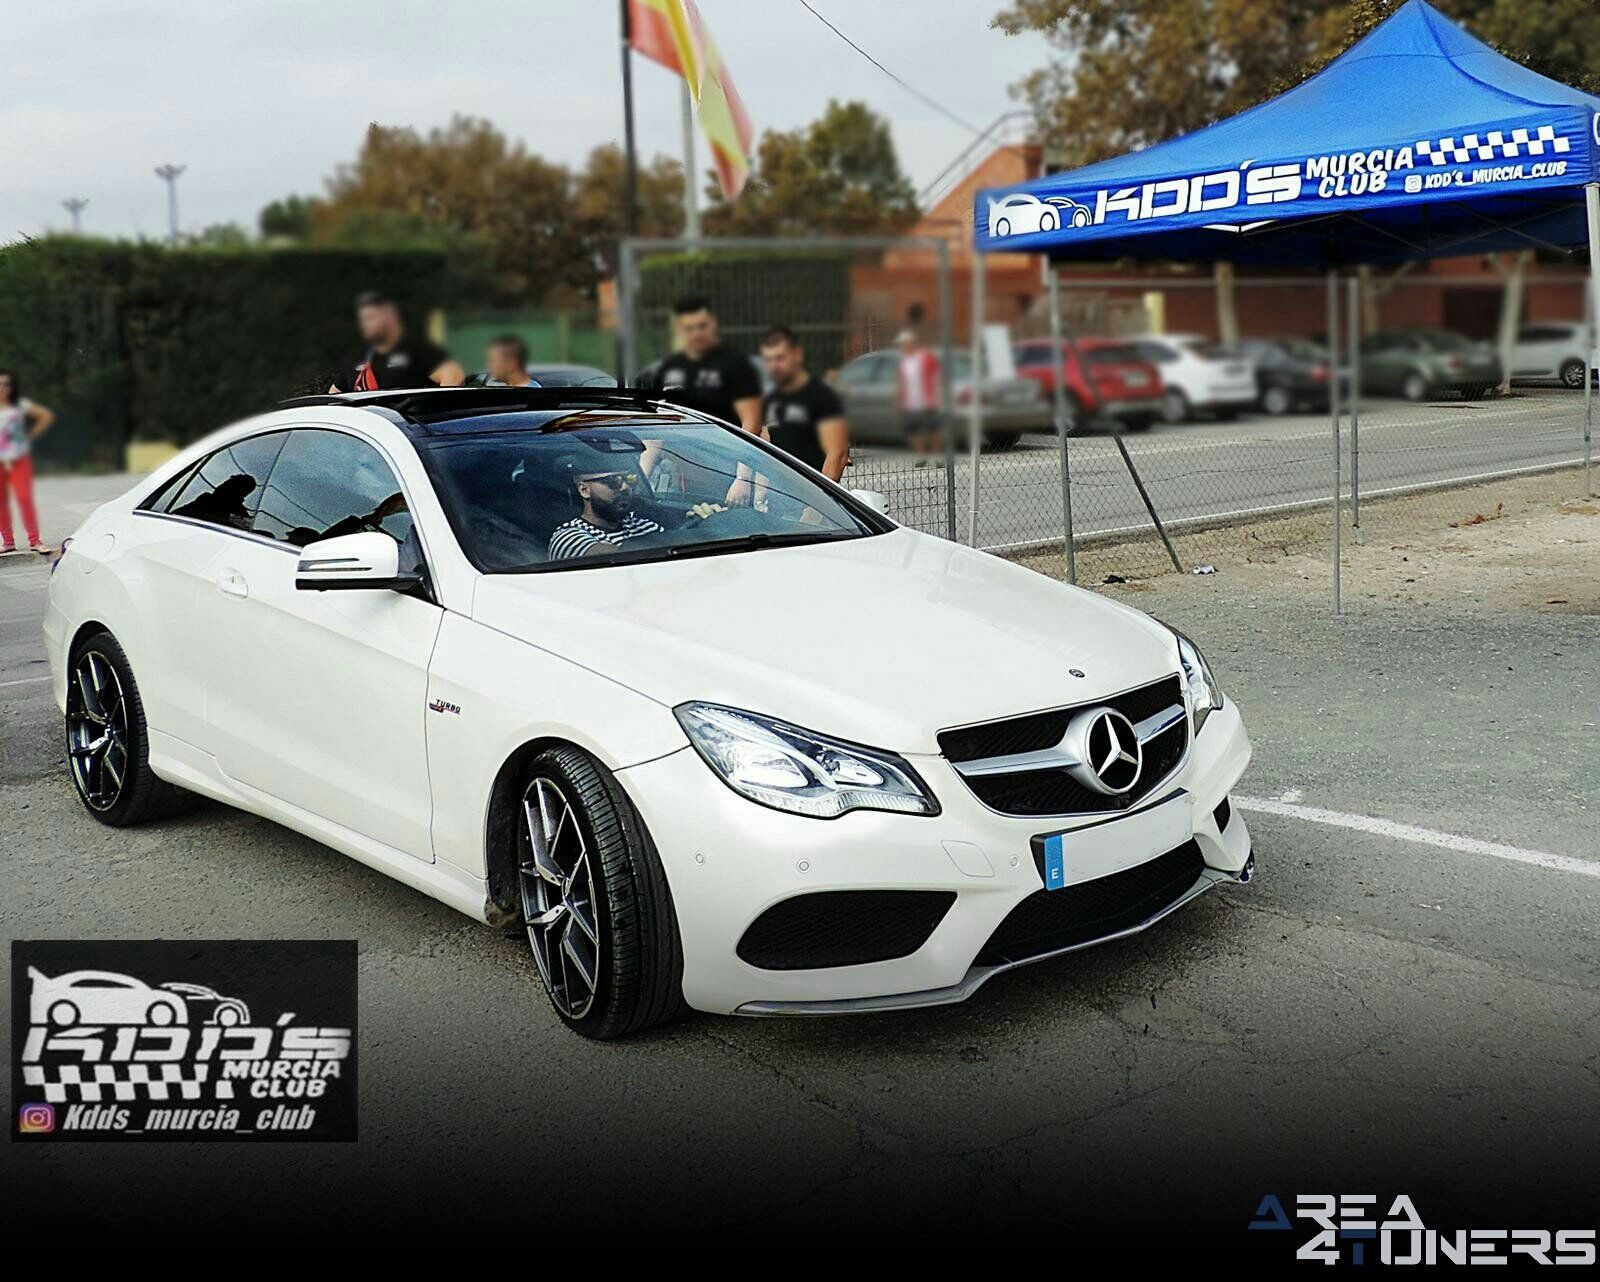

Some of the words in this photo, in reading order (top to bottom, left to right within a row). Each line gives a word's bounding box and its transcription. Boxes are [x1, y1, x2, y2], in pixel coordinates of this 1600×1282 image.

[1306, 147, 1413, 180] MURCIA
[1318, 170, 1387, 198] CLUB
[436, 699, 461, 713] TURBO
[1051, 868, 1059, 880] E
